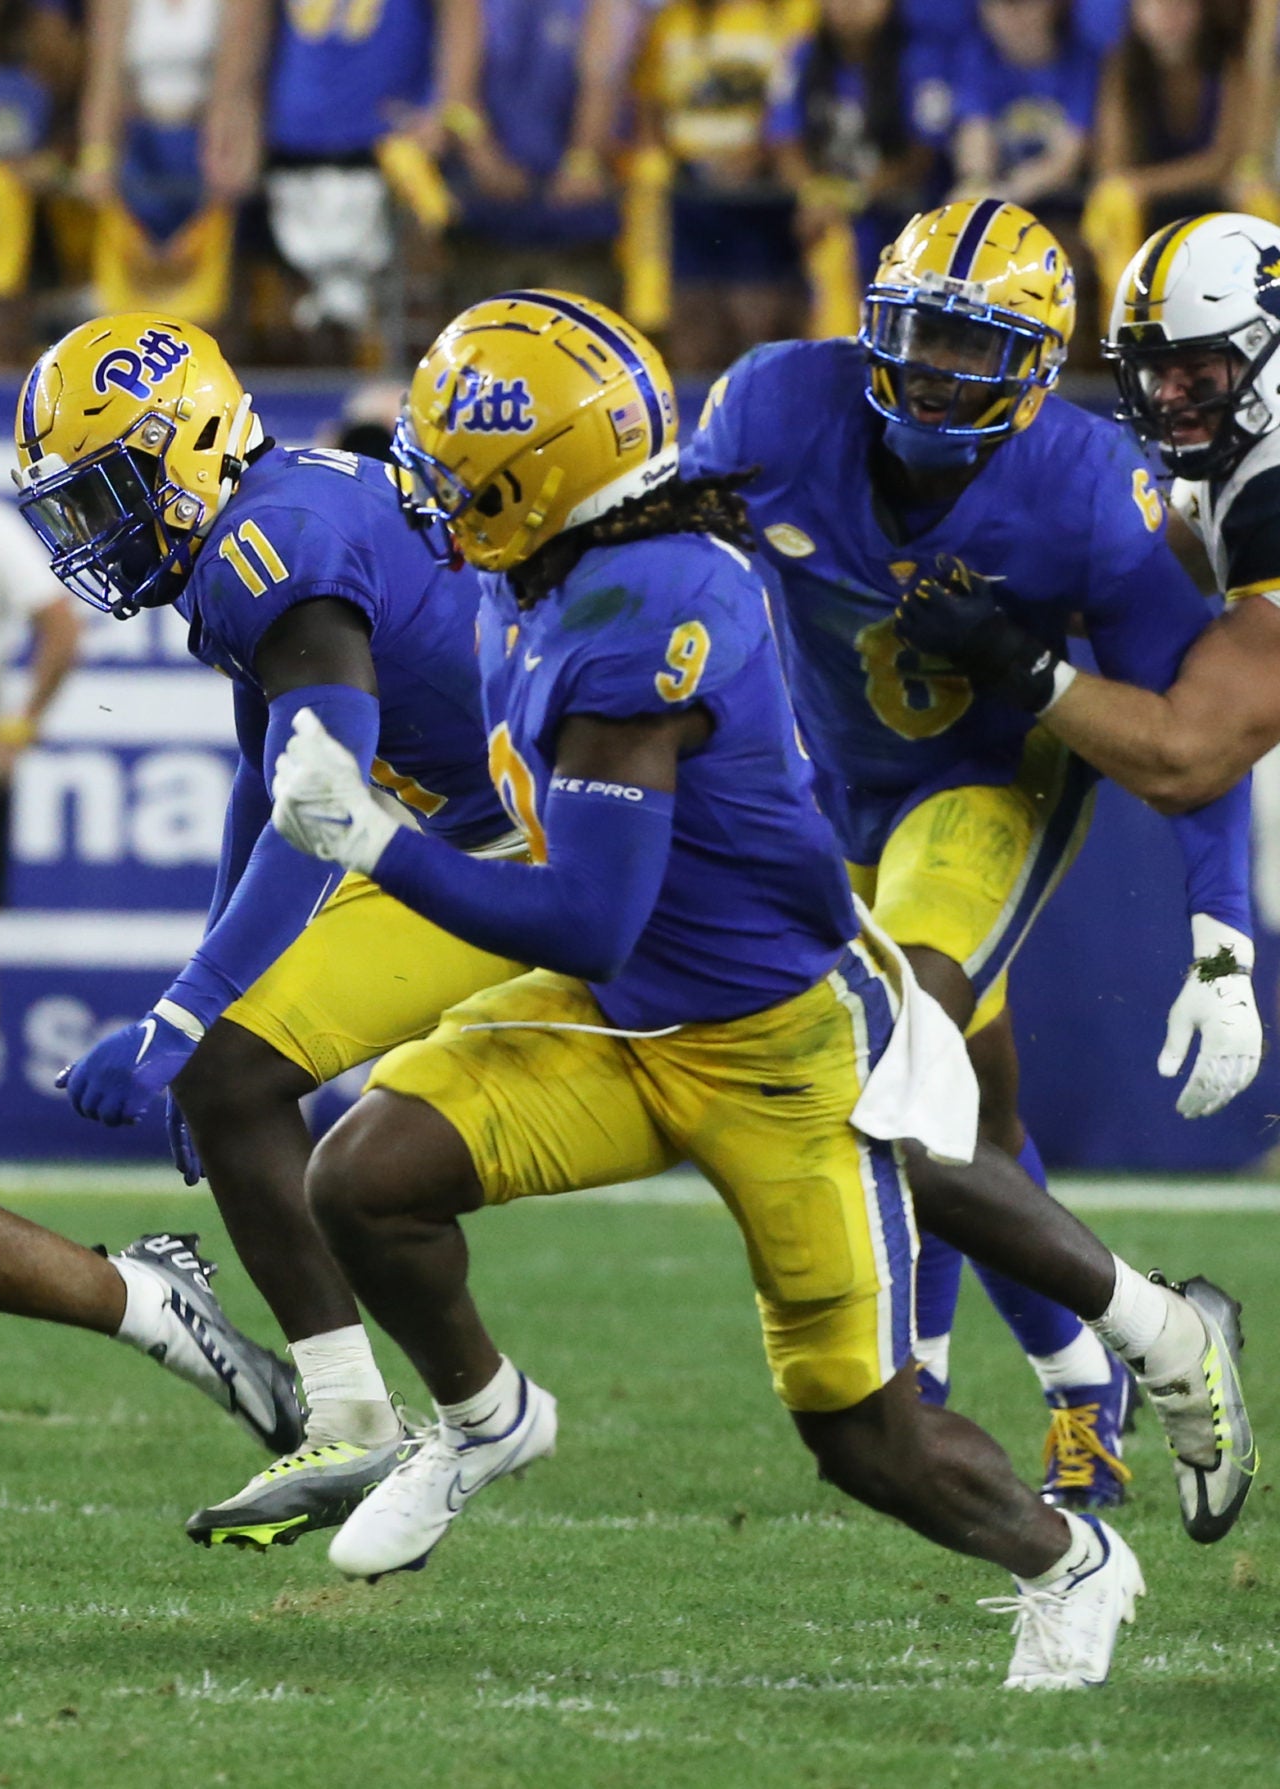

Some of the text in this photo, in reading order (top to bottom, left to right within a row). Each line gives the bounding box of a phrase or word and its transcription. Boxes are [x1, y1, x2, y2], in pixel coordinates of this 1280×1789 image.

[92, 328, 191, 401] Pitt
[434, 362, 538, 436] Pitt
[1132, 468, 1165, 533] 6
[218, 518, 290, 599] 11
[654, 619, 712, 704] 9
[550, 777, 644, 802] KE PRO
